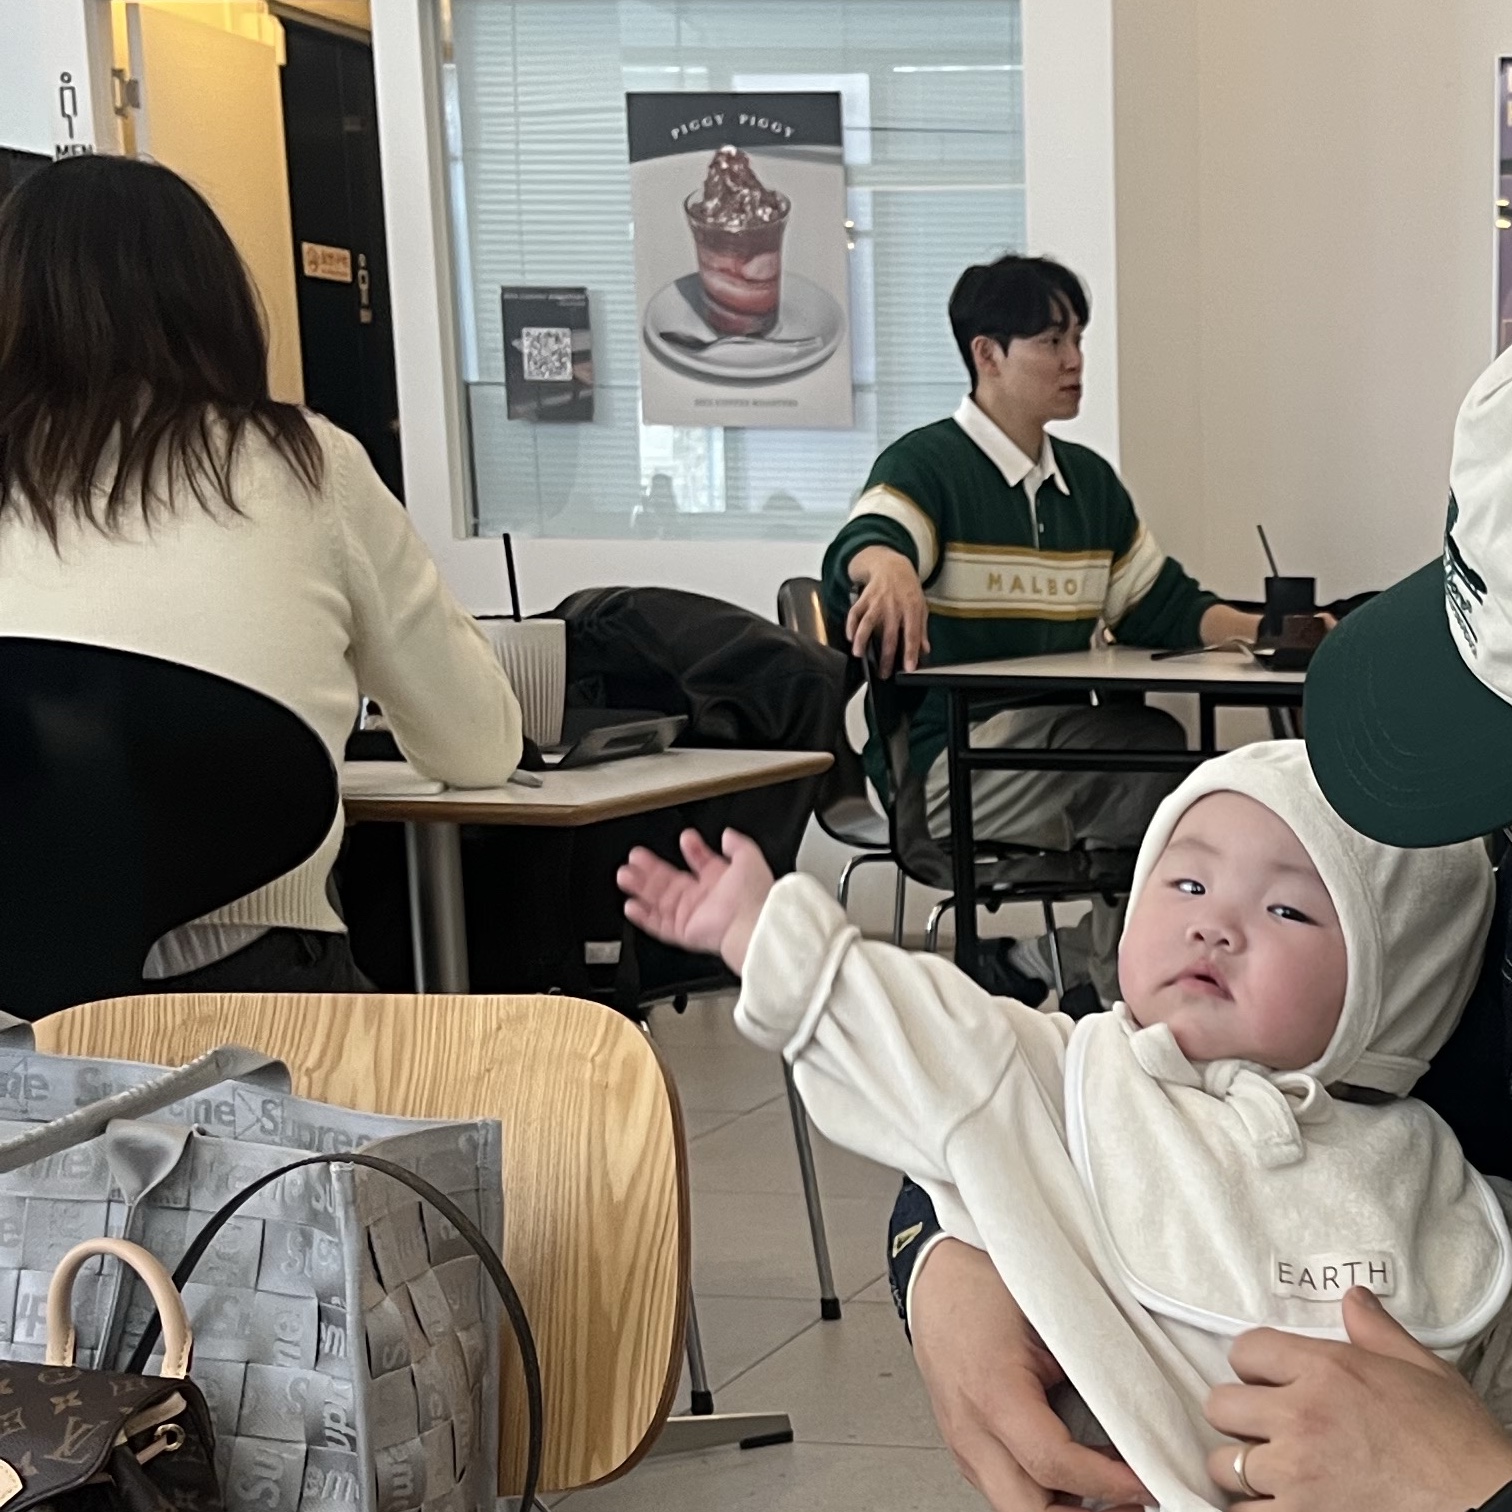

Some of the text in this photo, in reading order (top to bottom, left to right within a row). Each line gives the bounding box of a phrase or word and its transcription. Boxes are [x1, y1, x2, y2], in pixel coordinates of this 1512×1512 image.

[670, 112, 796, 140] PIGGY PIGGY
[1277, 1260, 1389, 1291] EARTH
